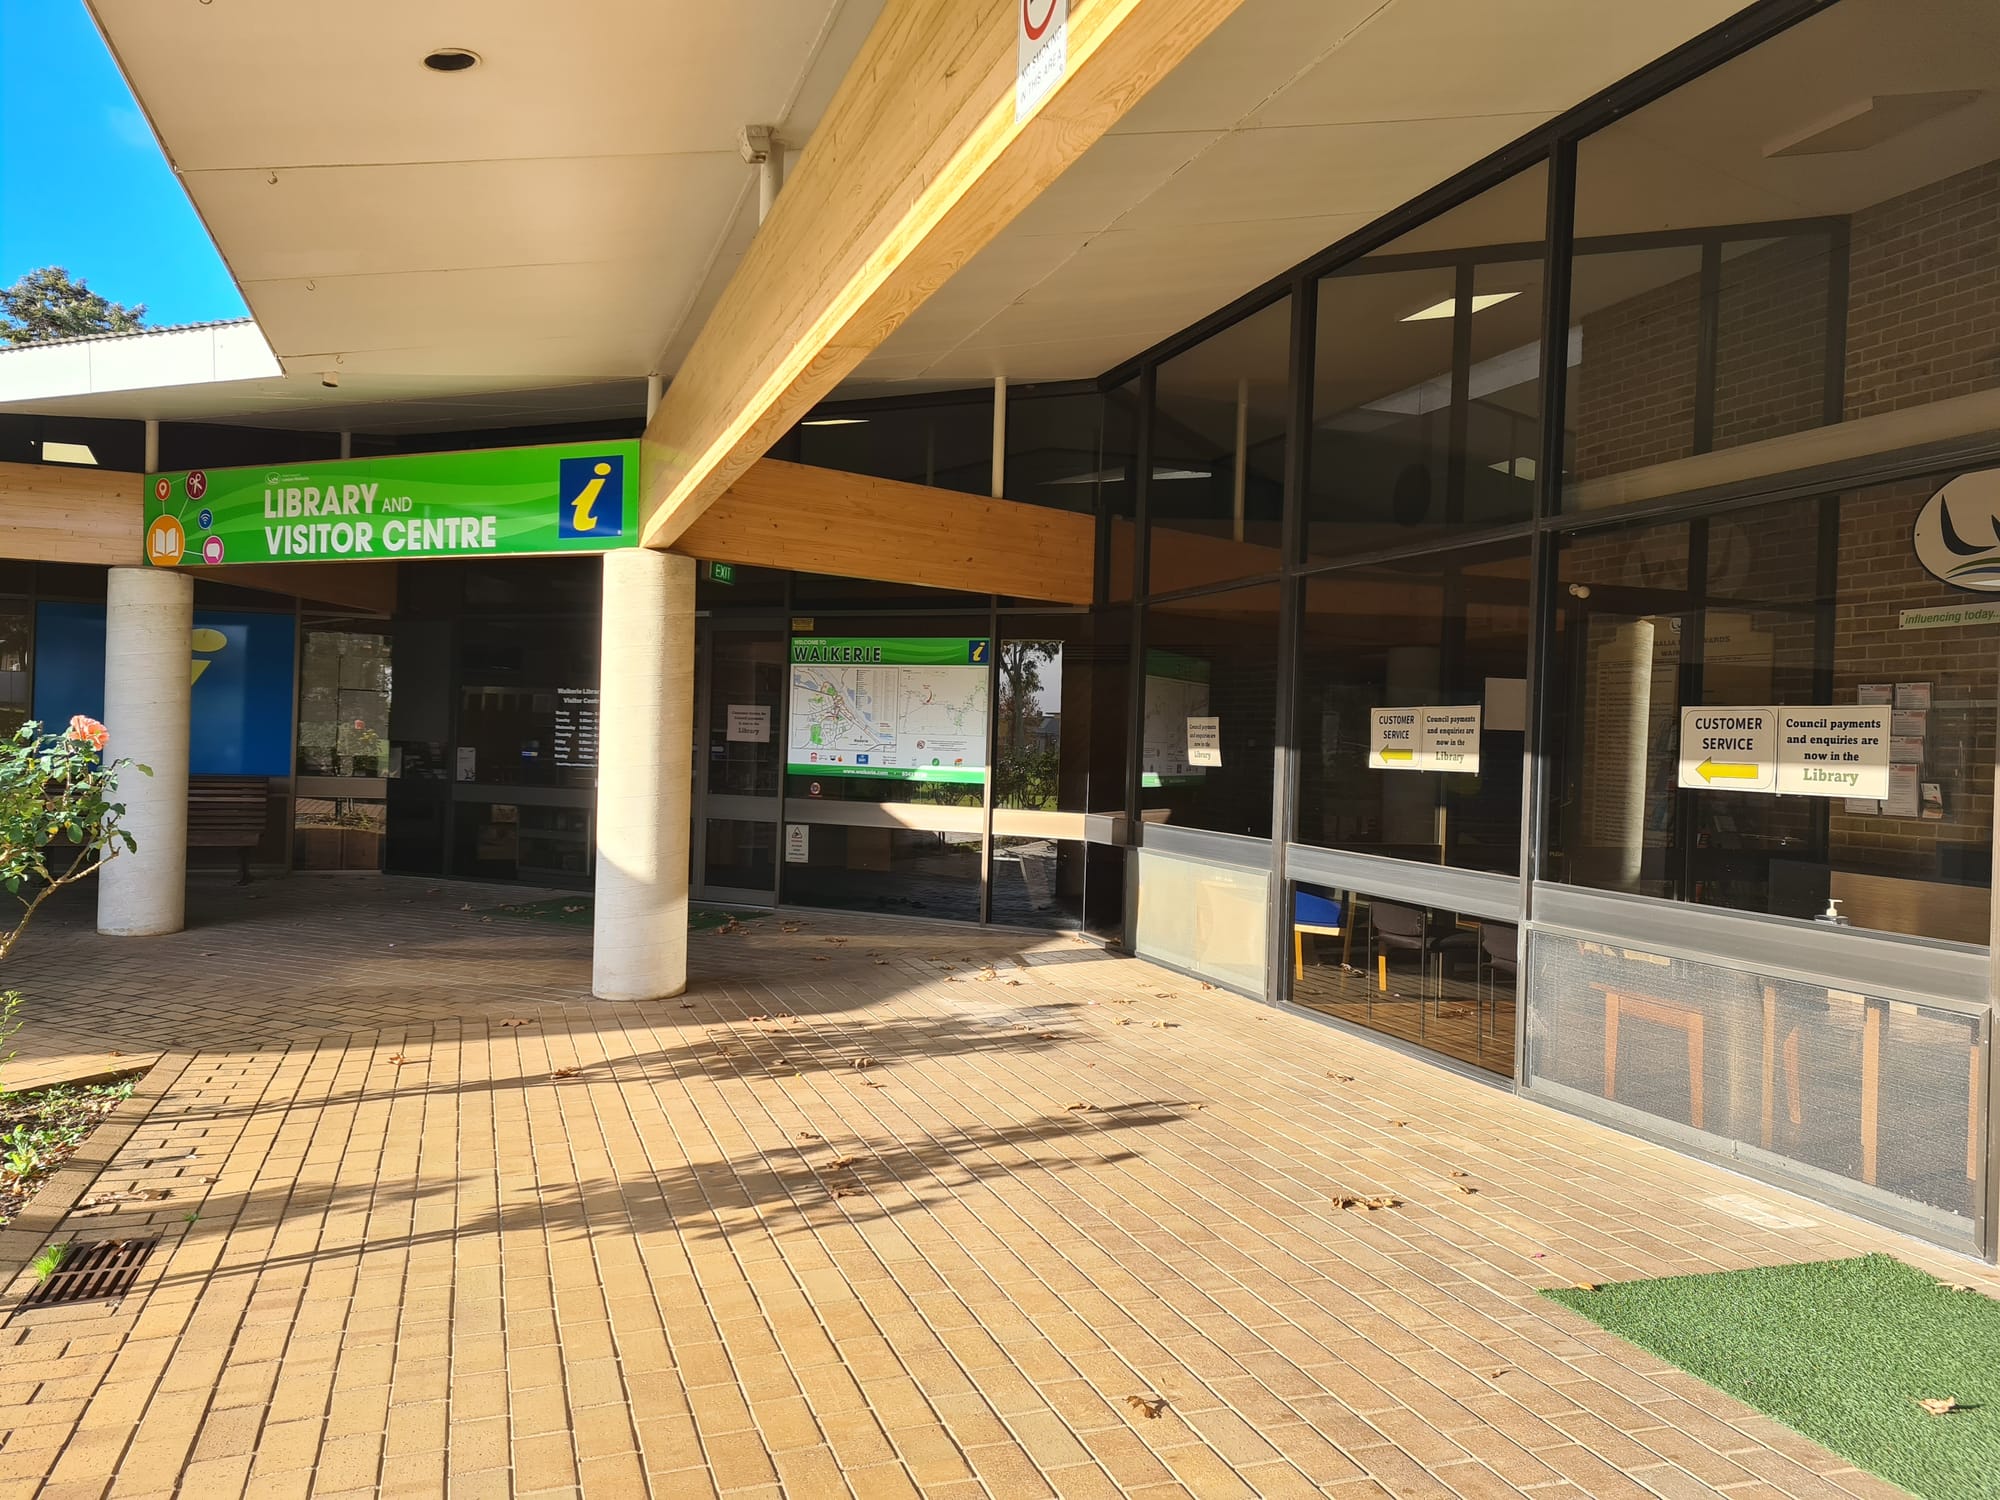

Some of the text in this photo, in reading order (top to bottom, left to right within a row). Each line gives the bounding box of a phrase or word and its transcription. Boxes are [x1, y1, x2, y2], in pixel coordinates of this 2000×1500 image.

[264, 483, 412, 519] LIBRARY AND
[265, 516, 497, 555] VISITOR CENTRE
[716, 564, 732, 580] EXIT
[1904, 612, 1962, 624] influencing
[793, 646, 882, 662] WAIKERIE
[1378, 715, 1414, 724] CUSTOMER
[1450, 716, 1476, 724] payments
[1695, 717, 1762, 730] CUSTOMER
[1786, 718, 1827, 728] Council
[1830, 719, 1881, 730] payments
[1383, 730, 1409, 739] SERVICE
[1786, 735, 1806, 744] and
[1810, 735, 1858, 746] enquiries
[1702, 738, 1753, 750] SERVICE
[1436, 752, 1464, 764] Library
[1830, 750, 1840, 760] in
[1843, 751, 1859, 761] the
[1803, 768, 1859, 786] Library
